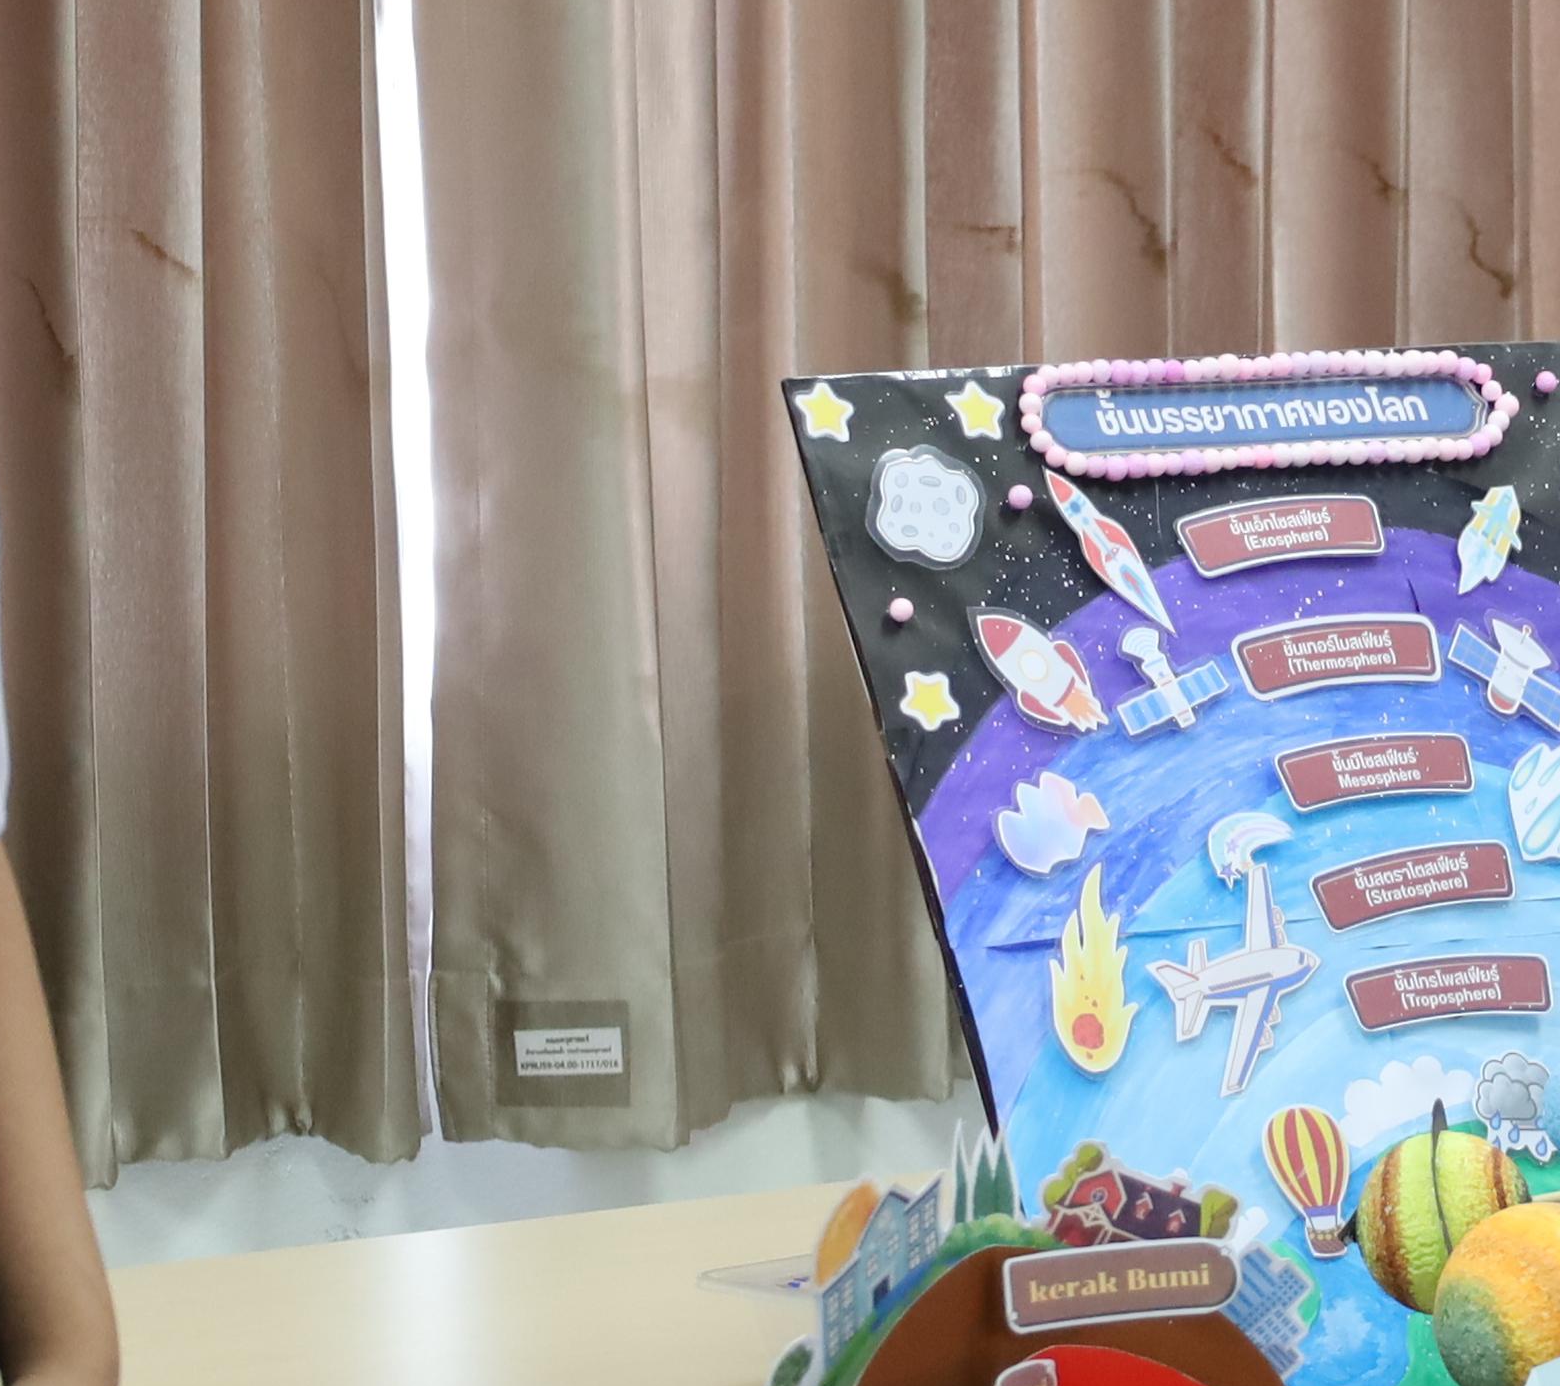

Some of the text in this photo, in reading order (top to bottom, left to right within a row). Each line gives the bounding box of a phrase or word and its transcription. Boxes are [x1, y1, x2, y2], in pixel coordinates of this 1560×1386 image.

[1095, 387, 1430, 436] ชั้นบรรยากาศของโลก
[1244, 526, 1329, 551] (Exosphere)
[1288, 647, 1397, 675] (Thermosphere)
[1338, 767, 1422, 789] Mesosphere
[1365, 871, 1469, 907] (Stratosphere)
[1401, 983, 1501, 1010] (Troposphere)
[1029, 1263, 1211, 1303] kerak Bumi
